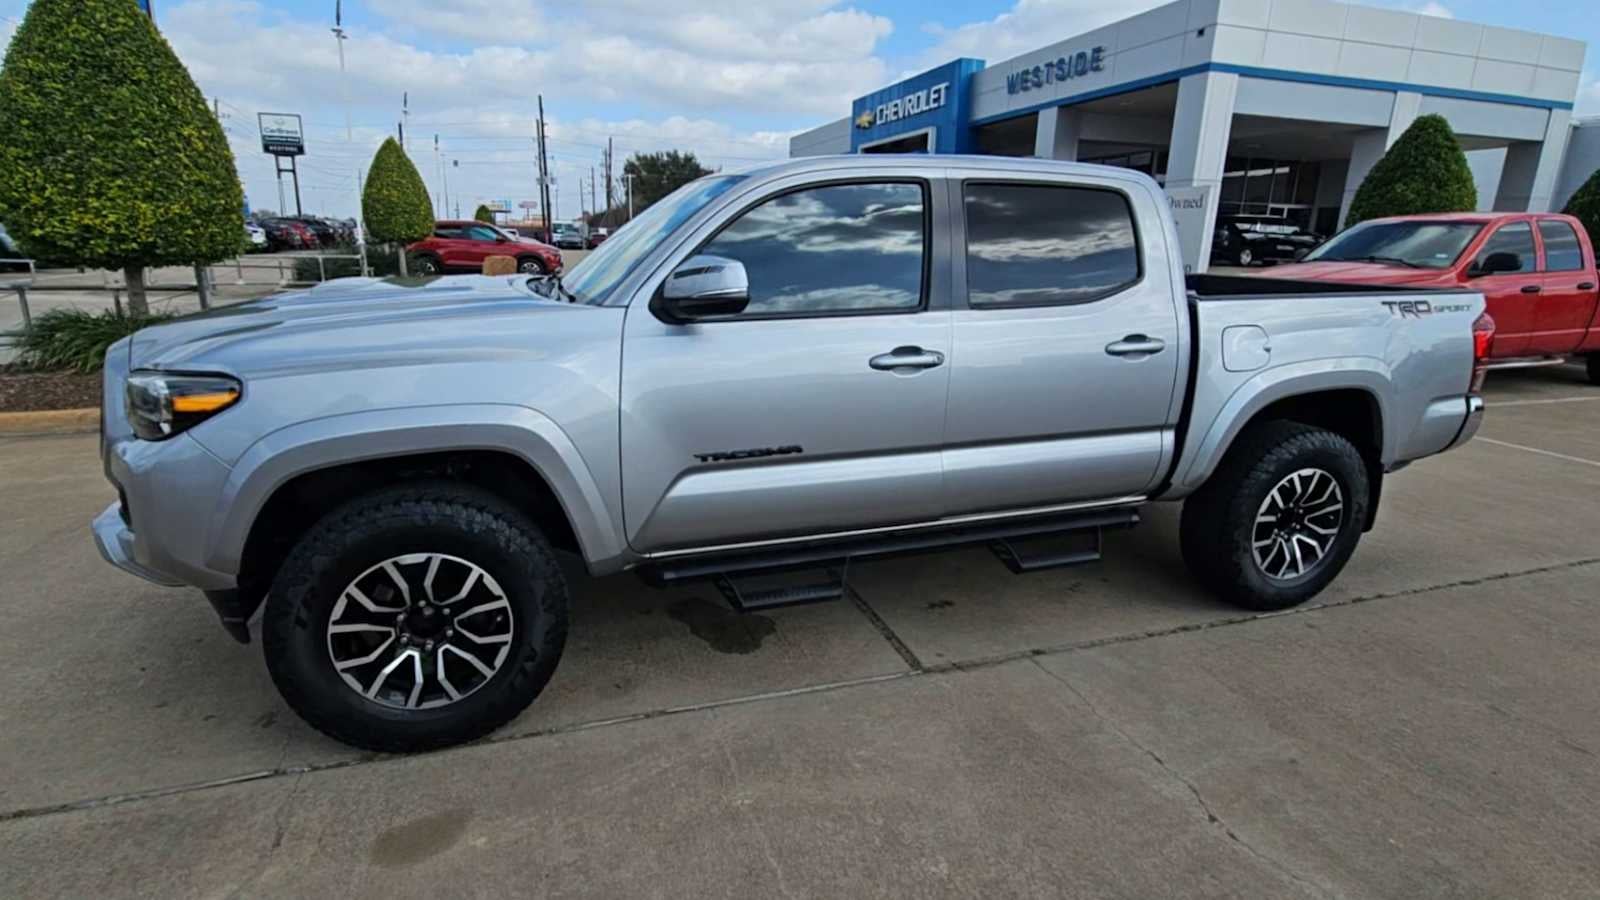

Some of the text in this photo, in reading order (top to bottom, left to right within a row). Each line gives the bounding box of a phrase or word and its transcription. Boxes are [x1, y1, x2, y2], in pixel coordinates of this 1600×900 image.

[1006, 46, 1104, 95] WESTSIDE
[875, 82, 949, 125] CHEVROLET
[1381, 300, 1472, 319] TRD SPORT
